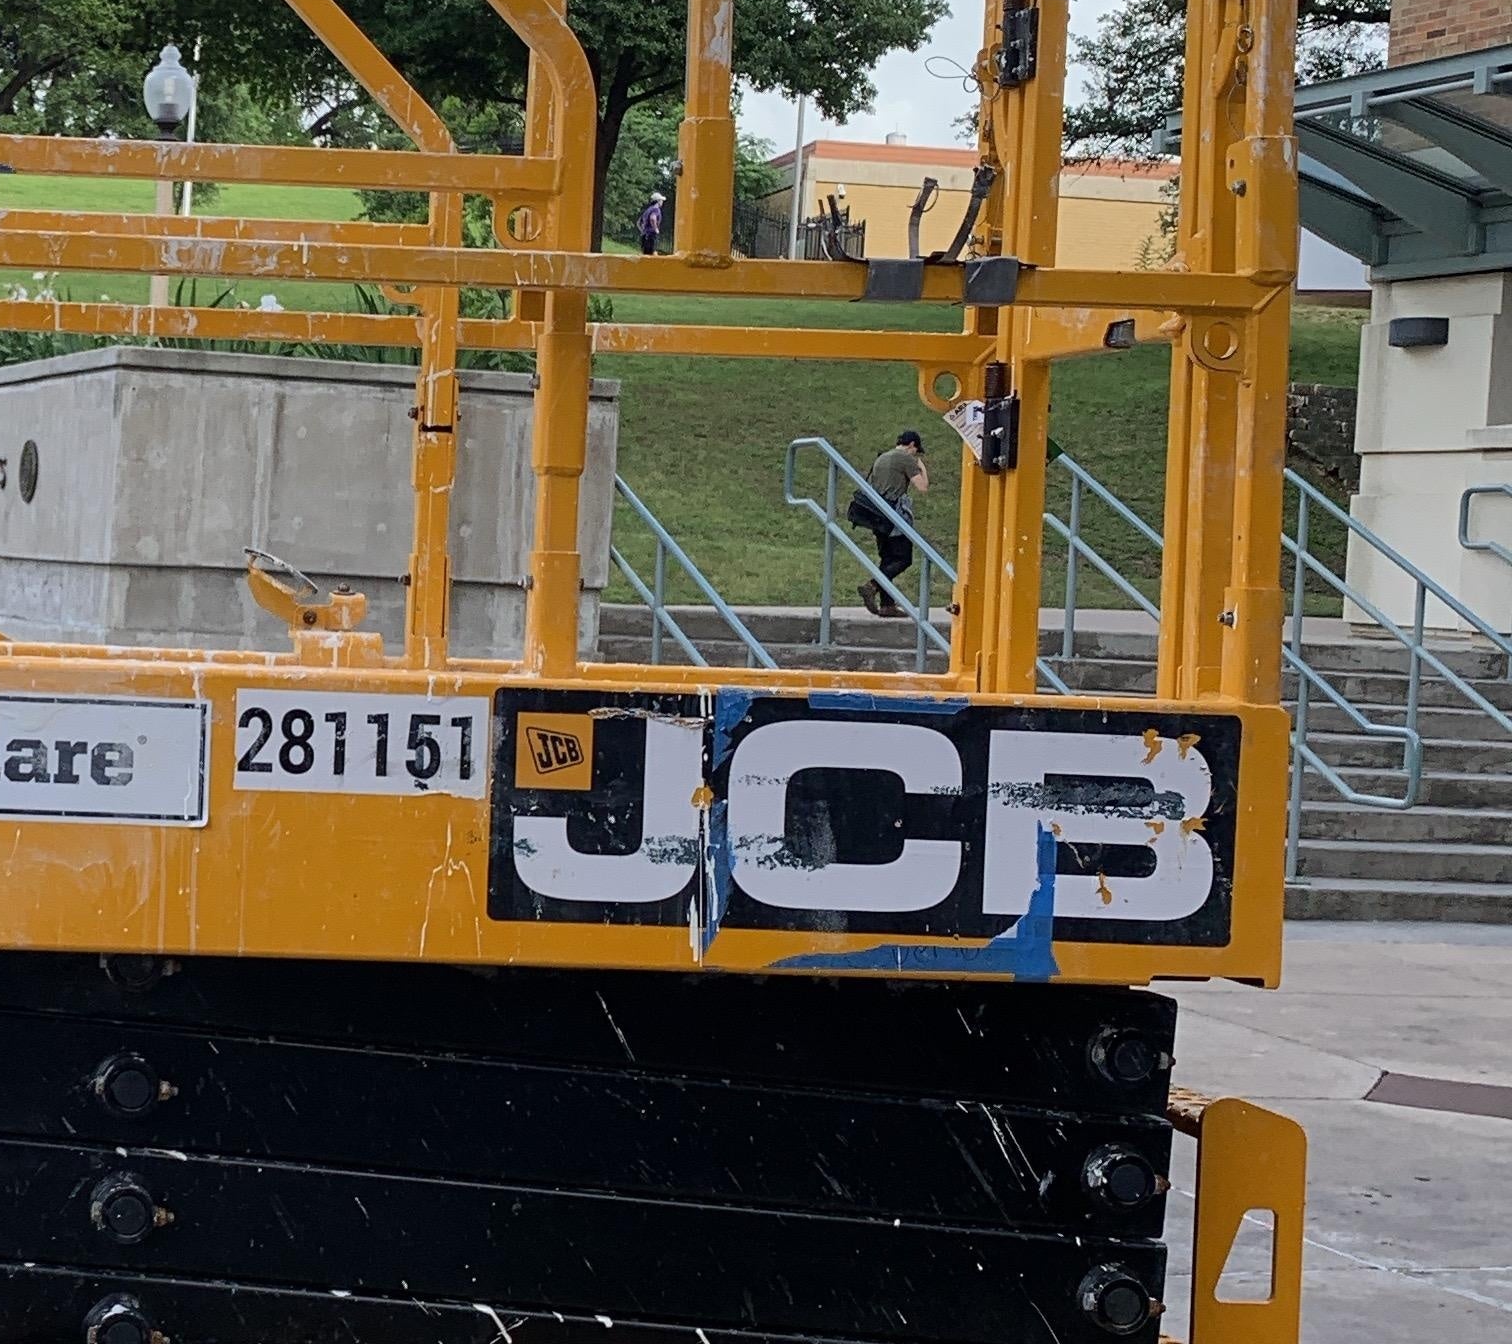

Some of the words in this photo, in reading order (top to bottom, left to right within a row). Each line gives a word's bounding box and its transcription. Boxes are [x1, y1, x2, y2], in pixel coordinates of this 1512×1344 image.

[237, 707, 474, 782] 281151
[536, 732, 580, 769] JCB
[512, 711, 1215, 921] JCB
